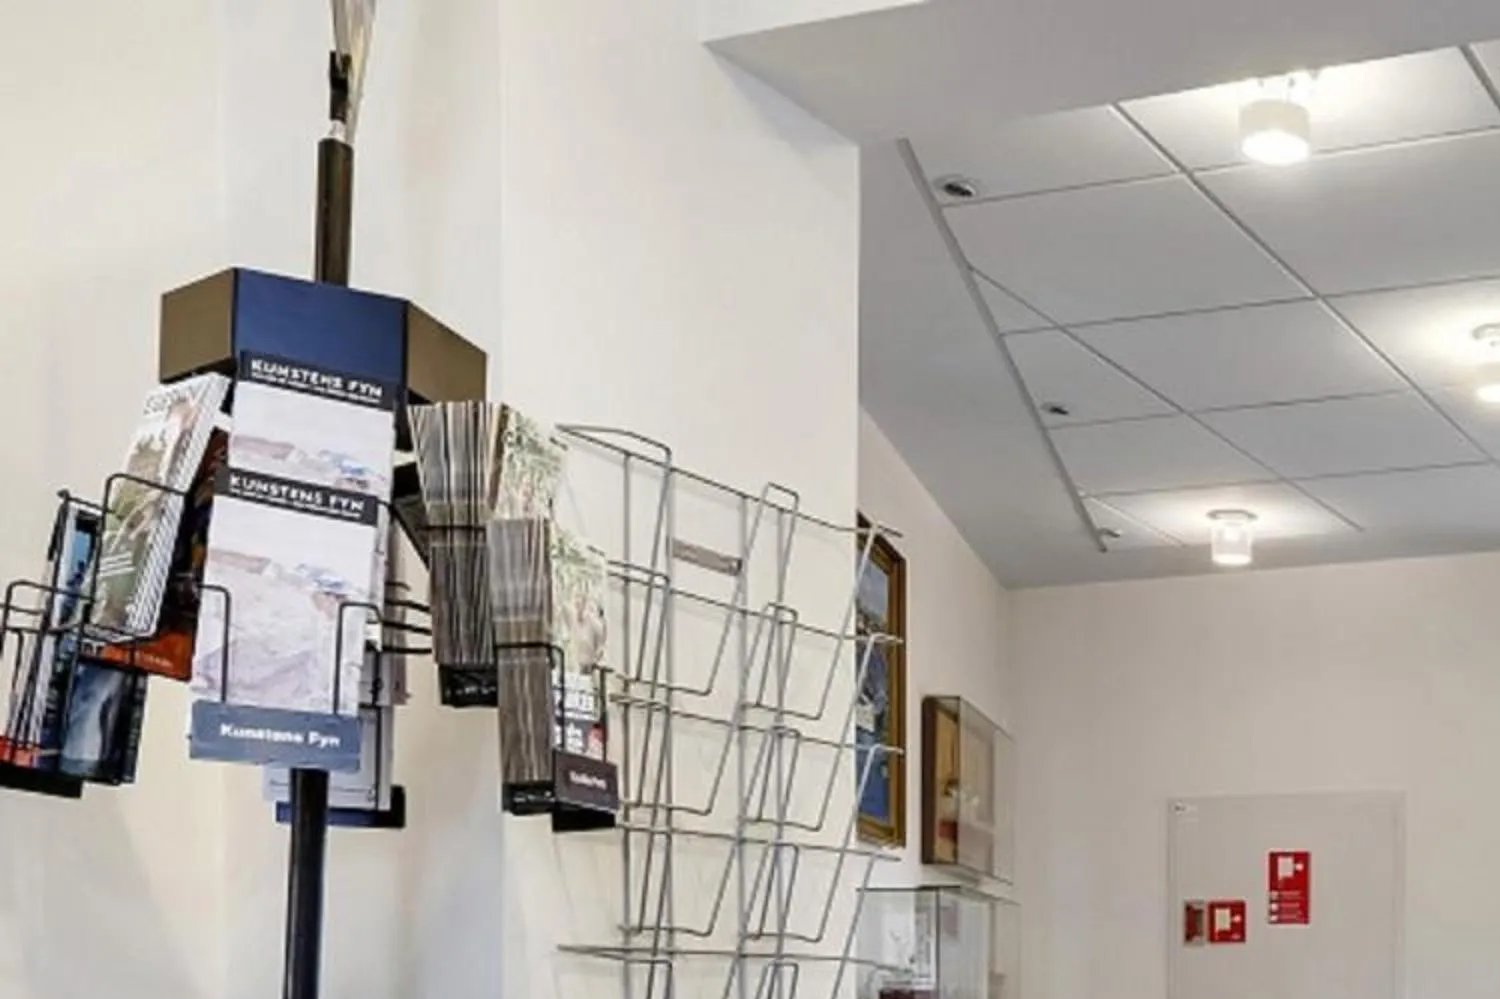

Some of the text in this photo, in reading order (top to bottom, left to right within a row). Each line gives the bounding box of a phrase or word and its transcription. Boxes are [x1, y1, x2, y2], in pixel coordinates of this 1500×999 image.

[251, 359, 343, 389] KUNSTENS
[347, 379, 383, 398] FYN
[229, 473, 322, 505] KUNSTENS
[329, 494, 365, 512] FYN
[220, 722, 341, 748] Kunstens Fyn
